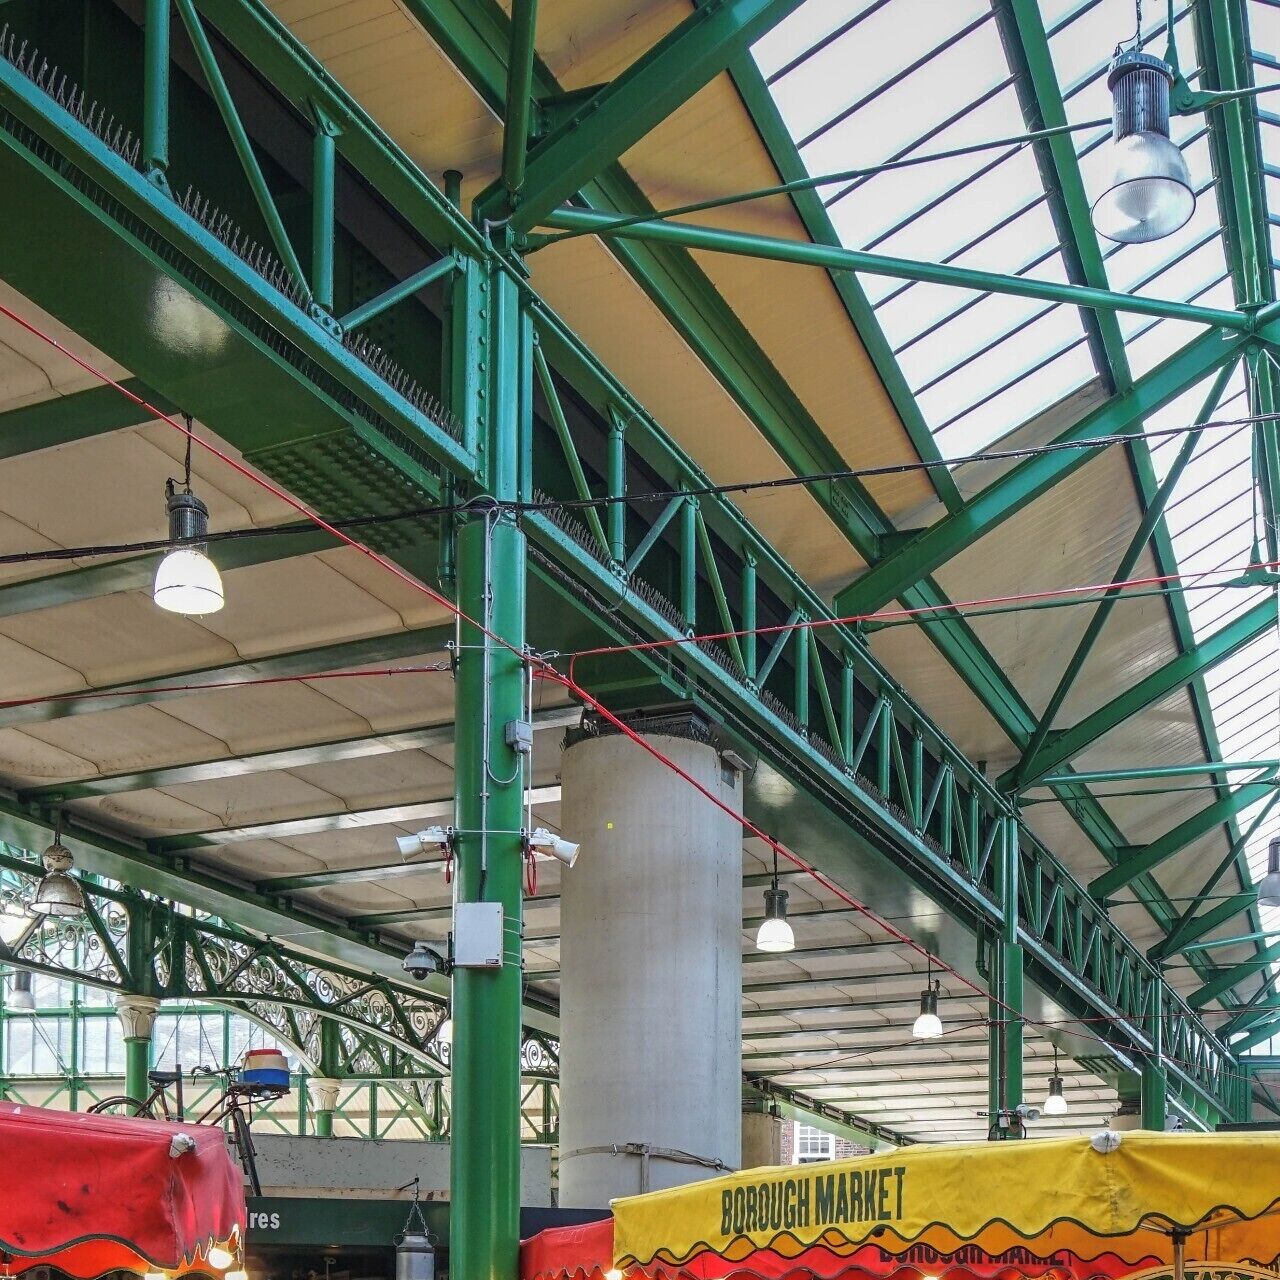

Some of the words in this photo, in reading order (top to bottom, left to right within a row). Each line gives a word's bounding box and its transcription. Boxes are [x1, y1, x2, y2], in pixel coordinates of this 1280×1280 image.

[245, 1207, 280, 1229] res
[721, 1178, 811, 1235] BOROUGH
[815, 1166, 905, 1225] MARKET
